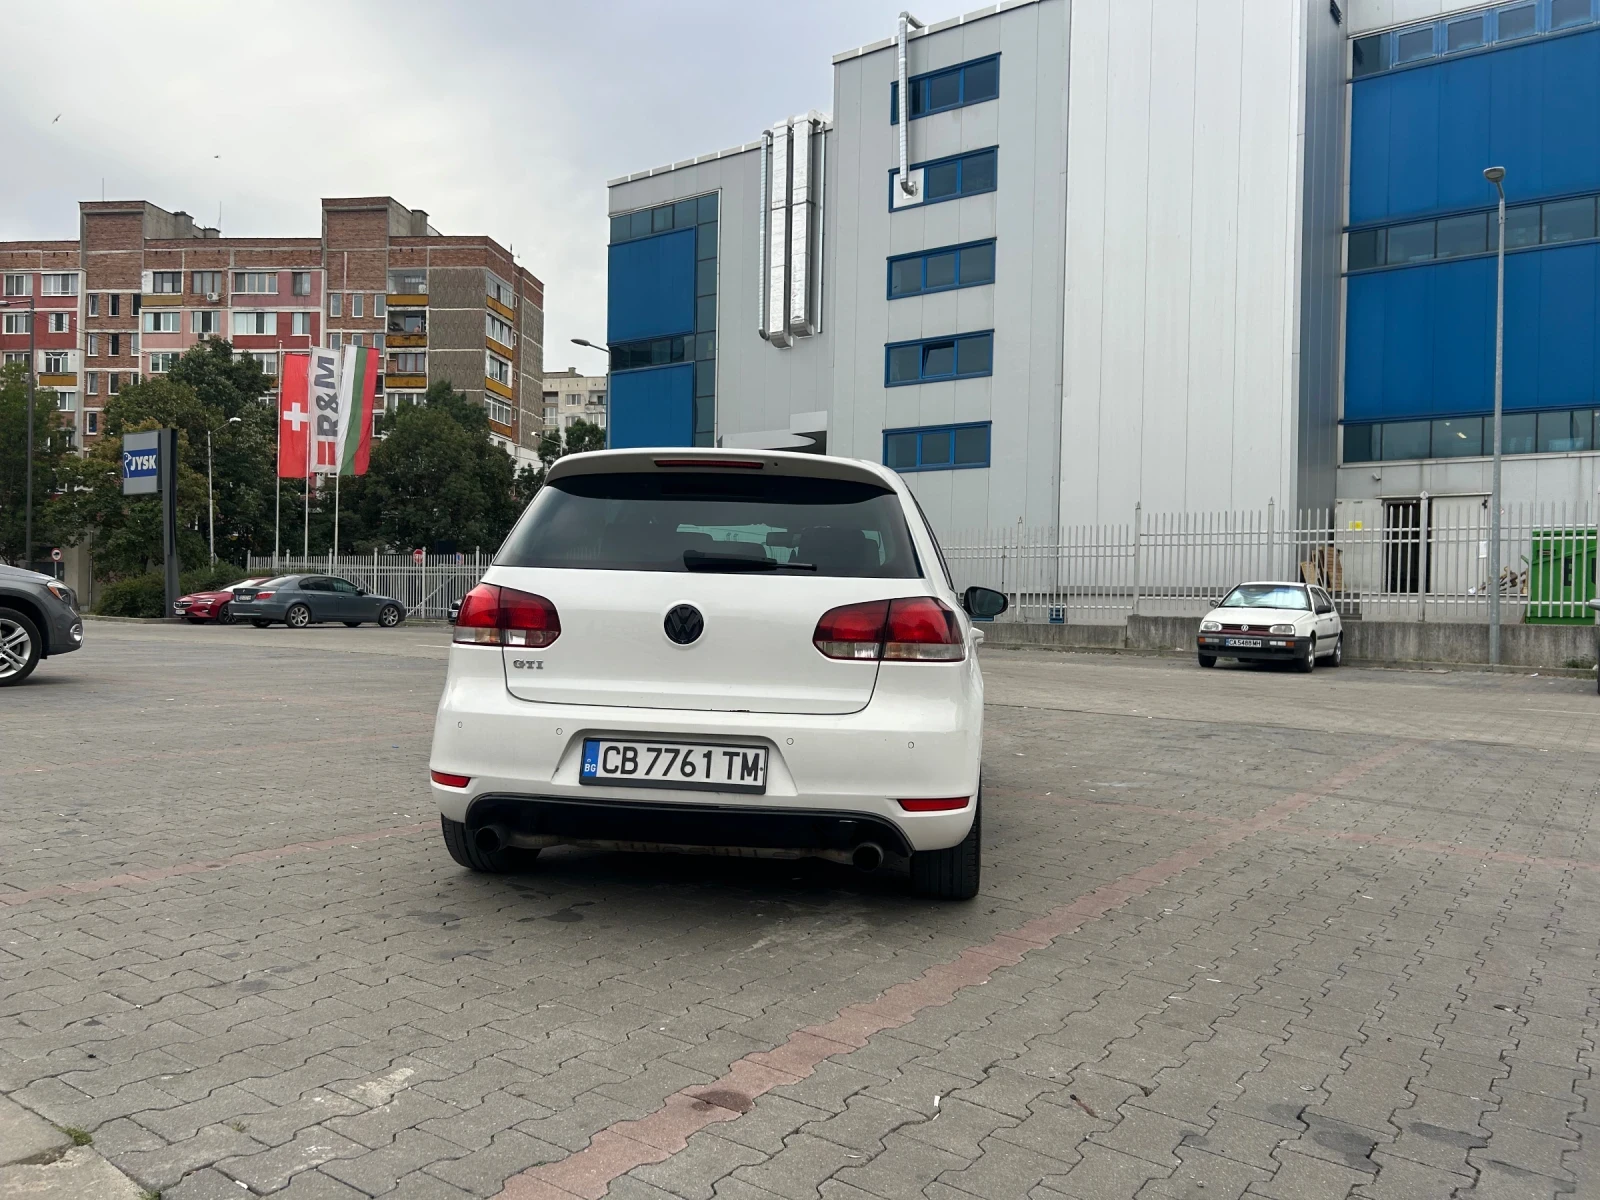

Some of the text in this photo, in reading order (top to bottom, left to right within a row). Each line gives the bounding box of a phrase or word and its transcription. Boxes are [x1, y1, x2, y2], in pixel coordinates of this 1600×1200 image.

[314, 355, 339, 437] R&M
[130, 454, 157, 471] JYSK
[513, 659, 544, 670] GTI
[584, 763, 597, 772] BG
[602, 745, 760, 782] CB 7761 TM
